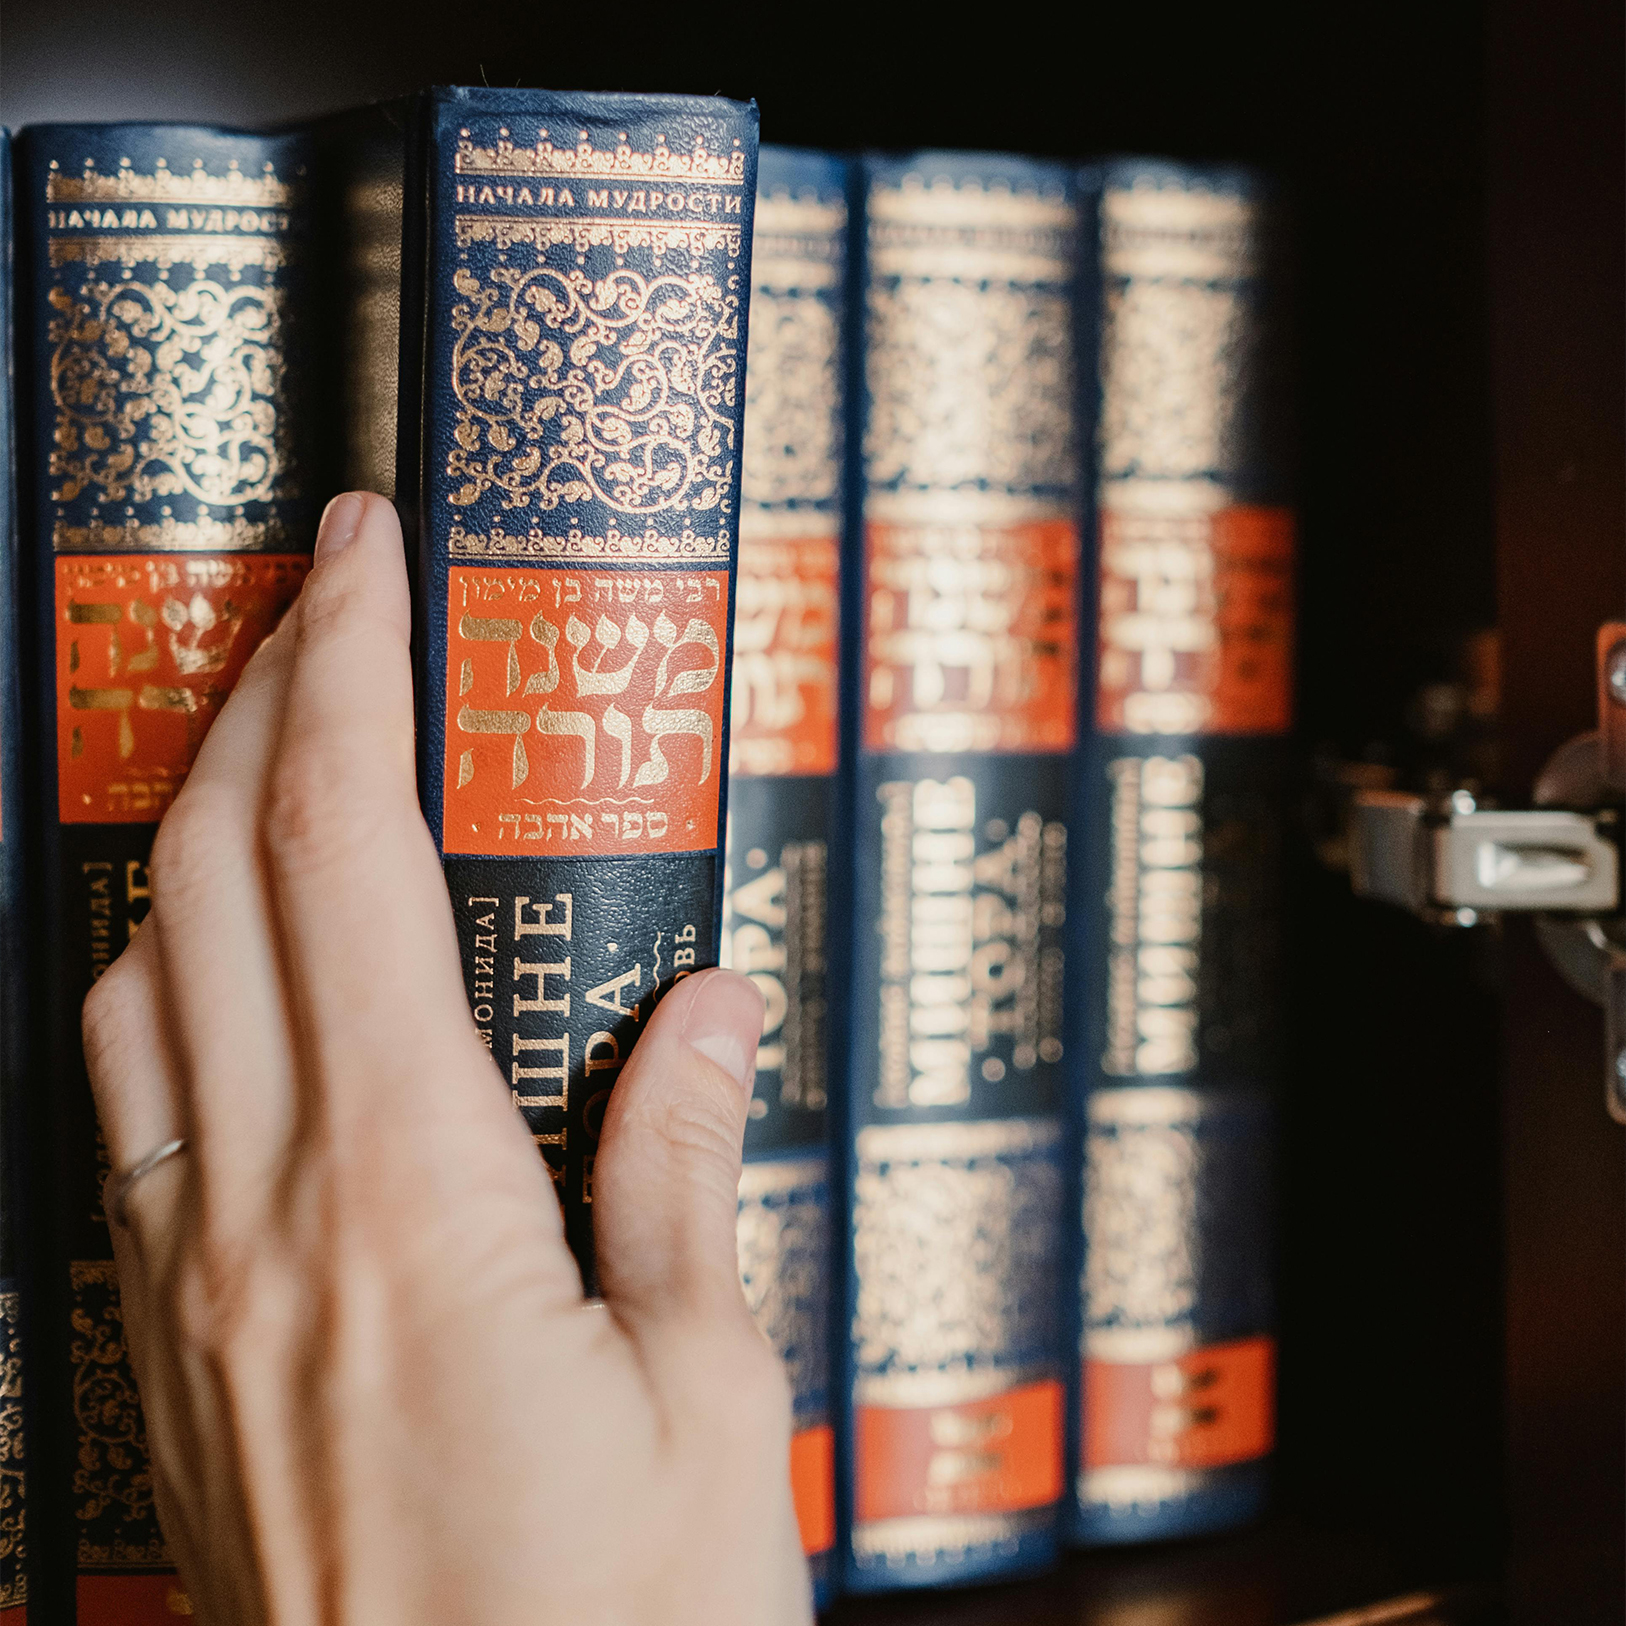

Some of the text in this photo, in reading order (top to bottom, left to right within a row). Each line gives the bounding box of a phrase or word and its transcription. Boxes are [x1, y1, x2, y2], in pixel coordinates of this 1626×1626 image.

[48, 207, 291, 233] НАЧАЛА МУДРОС
[455, 185, 742, 214] НАЧАЛА МУДРОСТИ
[459, 575, 721, 608] רבי משה בן מימון
[458, 608, 720, 699] משנה
[456, 701, 714, 791] תורה
[497, 810, 668, 842] ספר אהבה
[83, 860, 112, 975] ОНИДА]
[468, 895, 500, 1051] МОНИДА]
[512, 893, 573, 1190] ШНЕ
